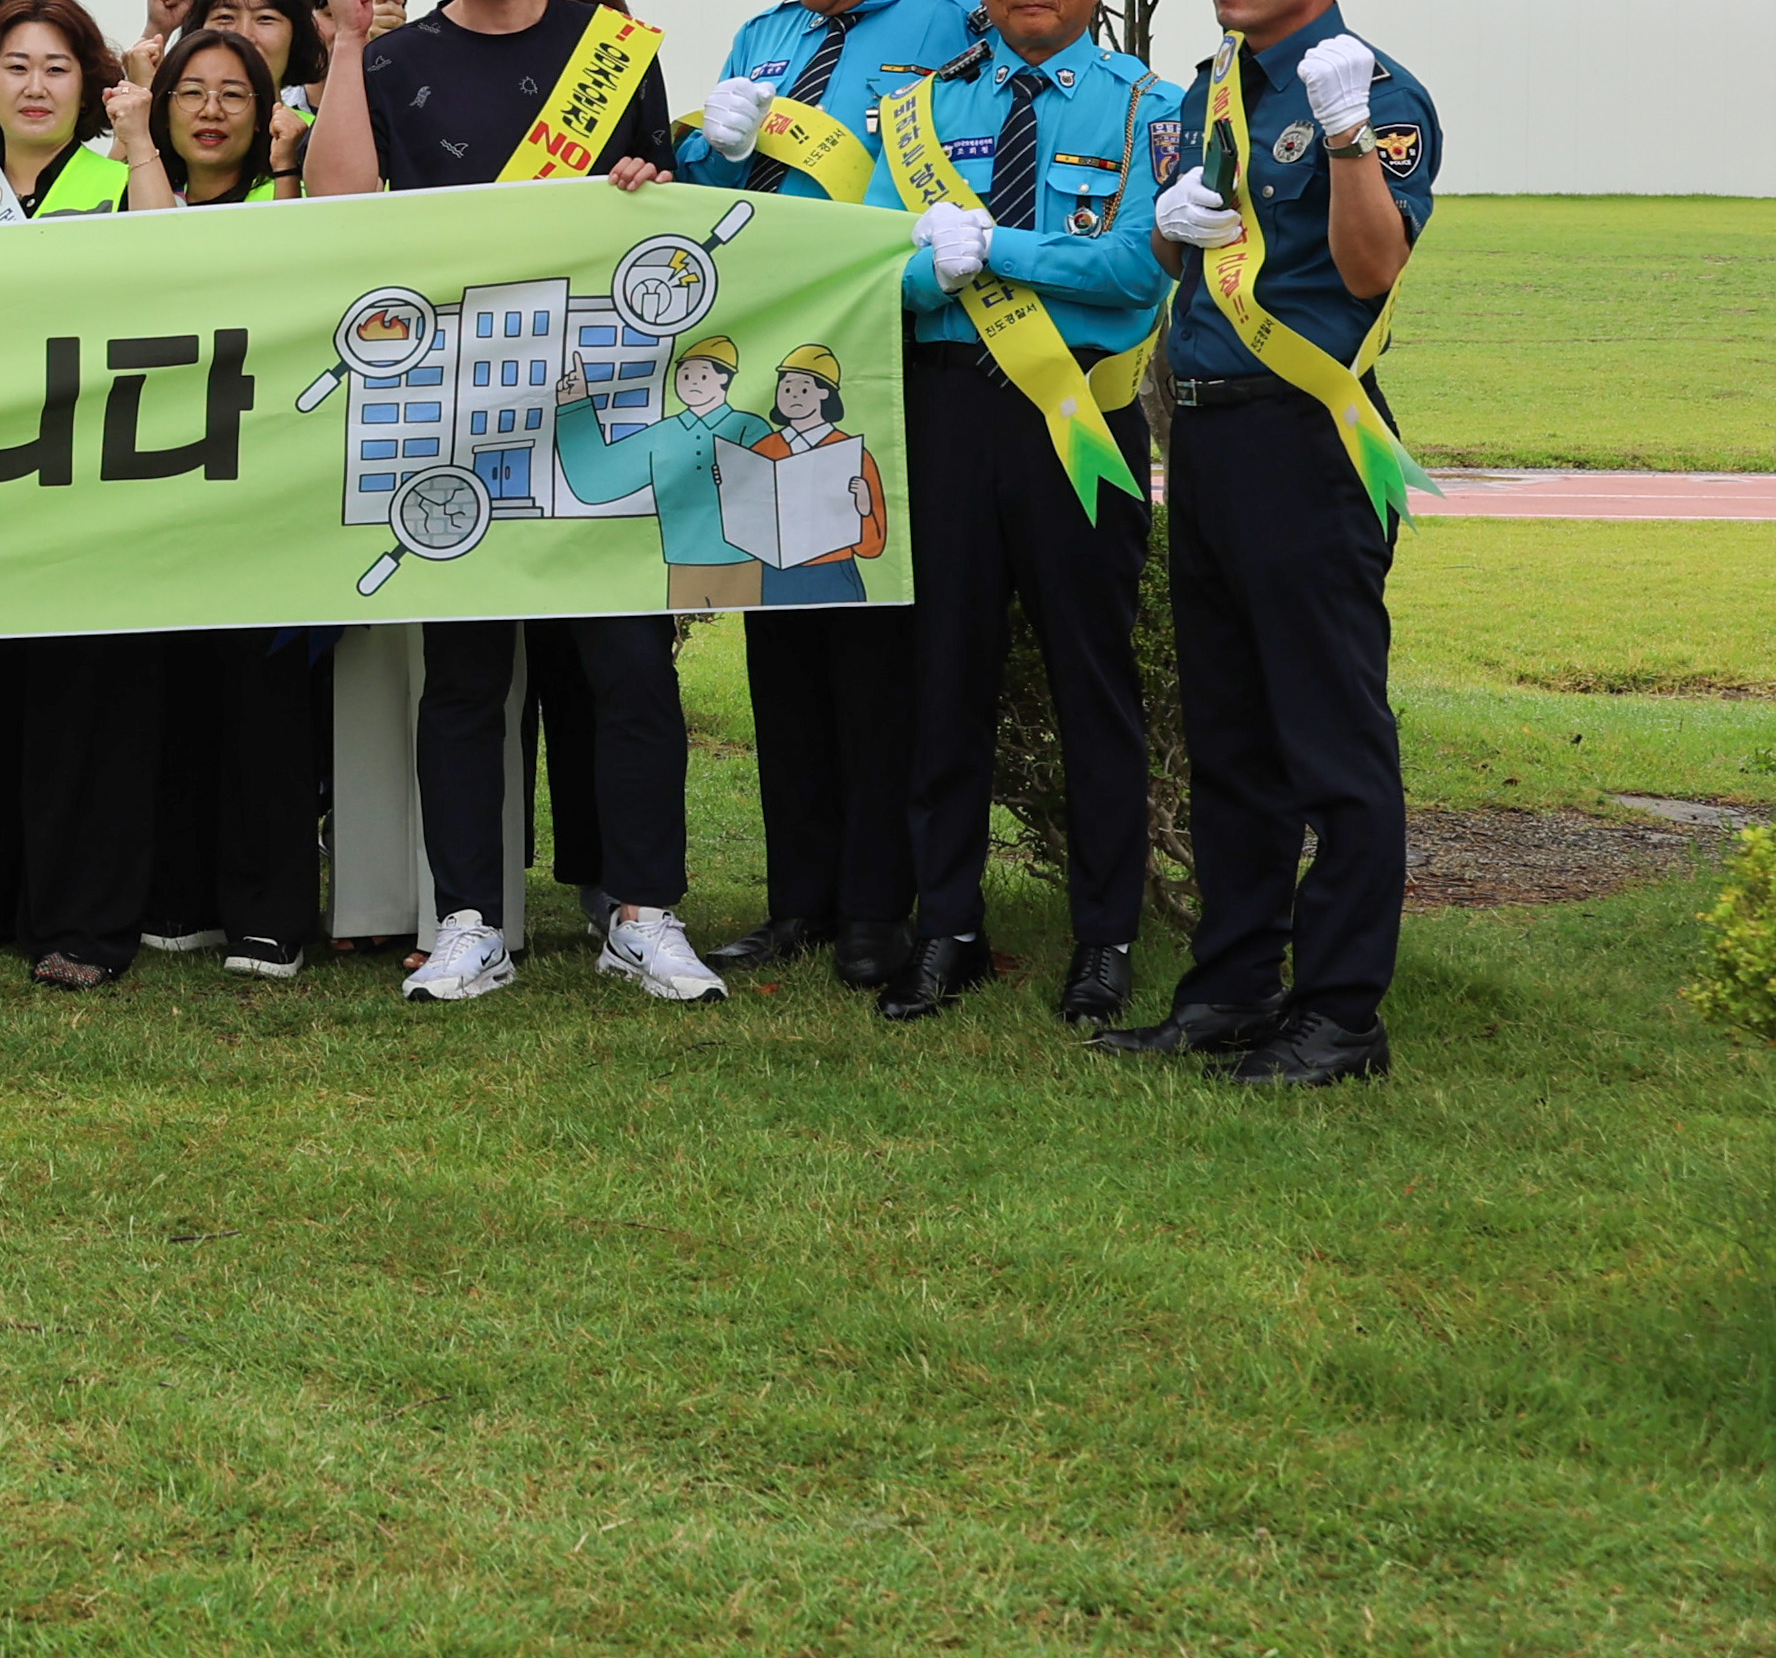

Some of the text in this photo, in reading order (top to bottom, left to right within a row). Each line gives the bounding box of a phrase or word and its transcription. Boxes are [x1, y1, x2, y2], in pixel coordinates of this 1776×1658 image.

[560, 42, 630, 138] 음주운전
[803, 128, 846, 167] 진도경찰서
[894, 96, 925, 167] 배려하는
[910, 163, 950, 206] 당신
[985, 302, 1038, 337] 진도경찰서
